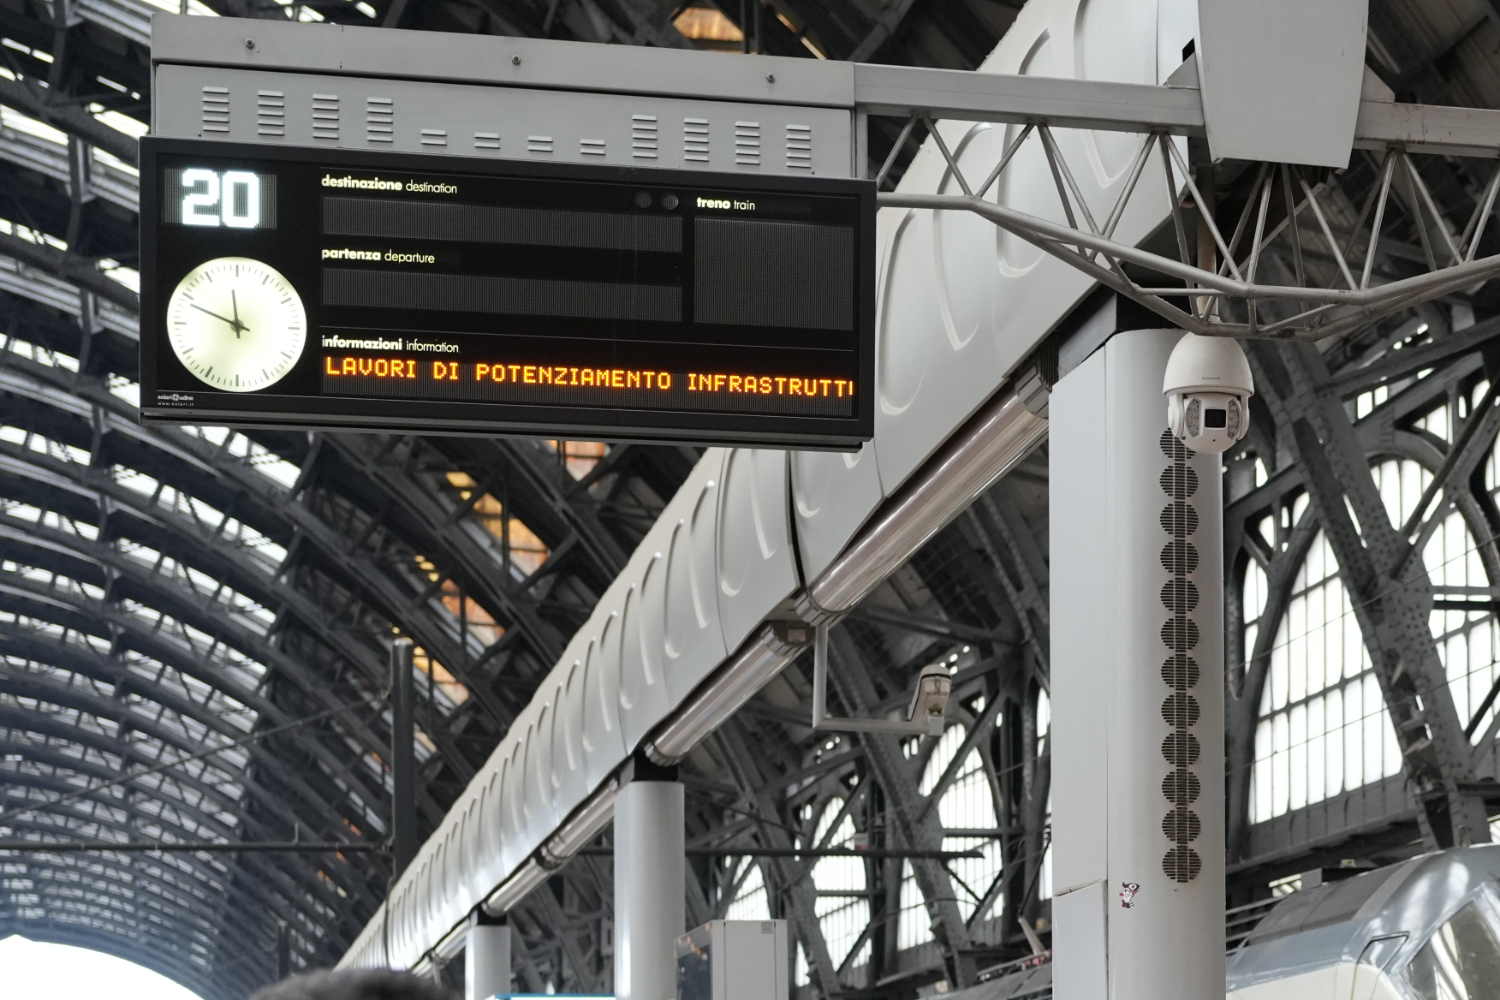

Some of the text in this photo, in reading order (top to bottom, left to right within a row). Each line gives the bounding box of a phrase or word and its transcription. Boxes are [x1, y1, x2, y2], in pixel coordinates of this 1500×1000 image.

[321, 174, 458, 194] destinazione destination
[182, 168, 259, 229] 20
[697, 197, 756, 211] treno train
[321, 248, 436, 265] partenza departure
[322, 335, 459, 353] informazioni information
[326, 356, 416, 378] LAVORI
[432, 361, 459, 380] DI
[475, 363, 672, 391] POTENZIAMENTO
